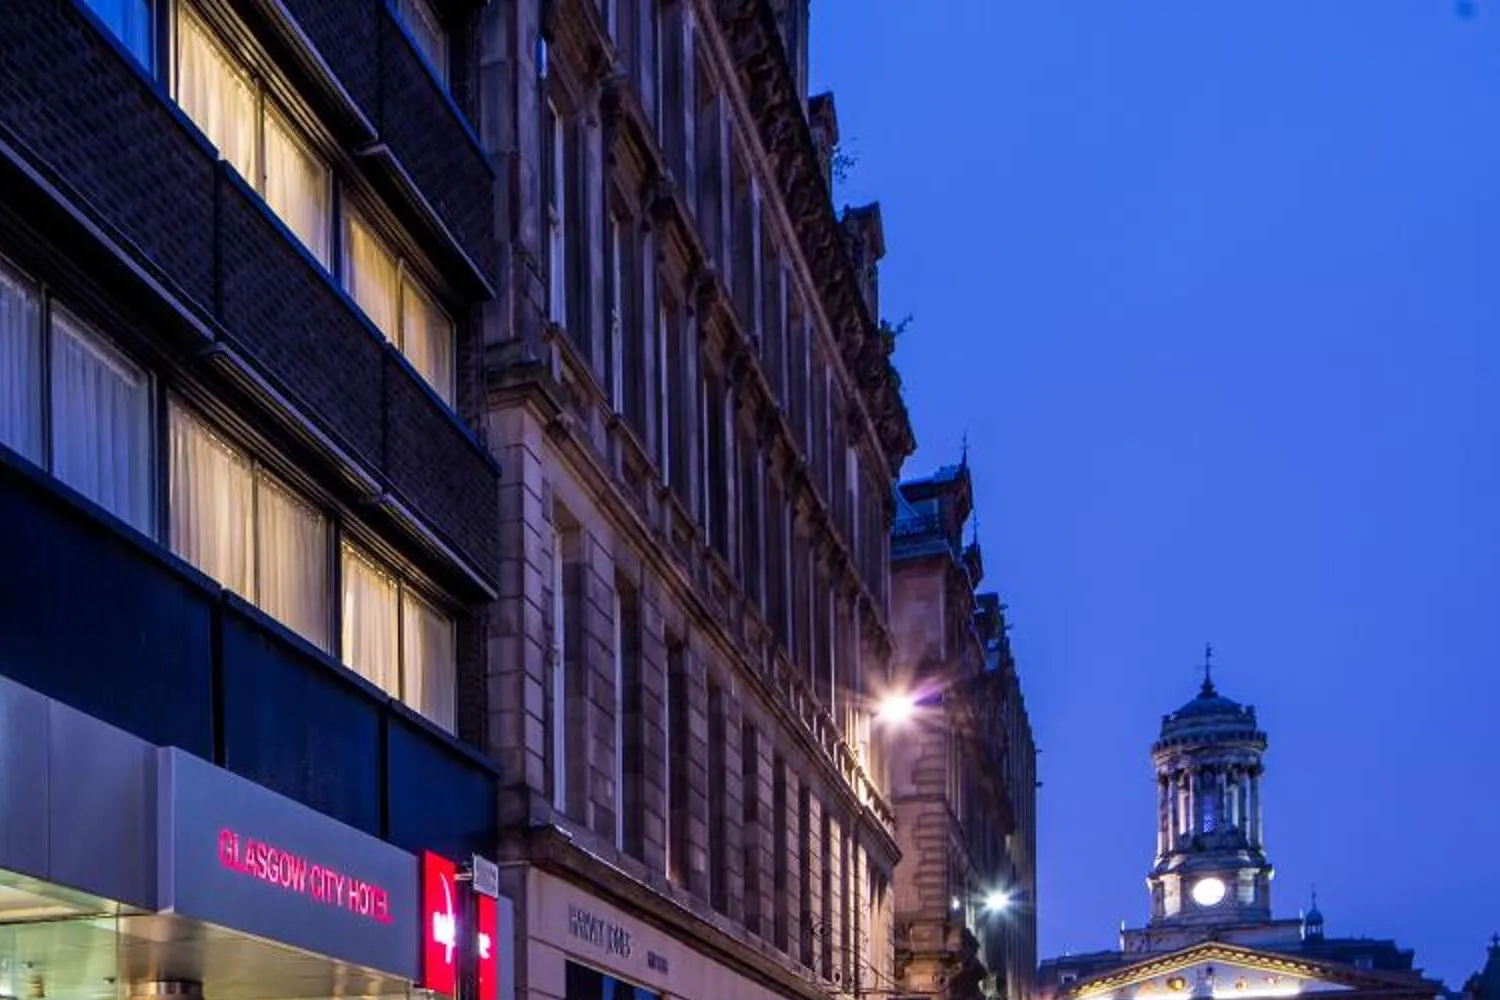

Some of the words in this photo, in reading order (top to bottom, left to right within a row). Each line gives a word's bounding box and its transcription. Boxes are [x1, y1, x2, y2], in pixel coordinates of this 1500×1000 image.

[217, 828, 308, 893] GLASGOW
[310, 863, 345, 907] CITY
[348, 880, 393, 926] HOTEL
